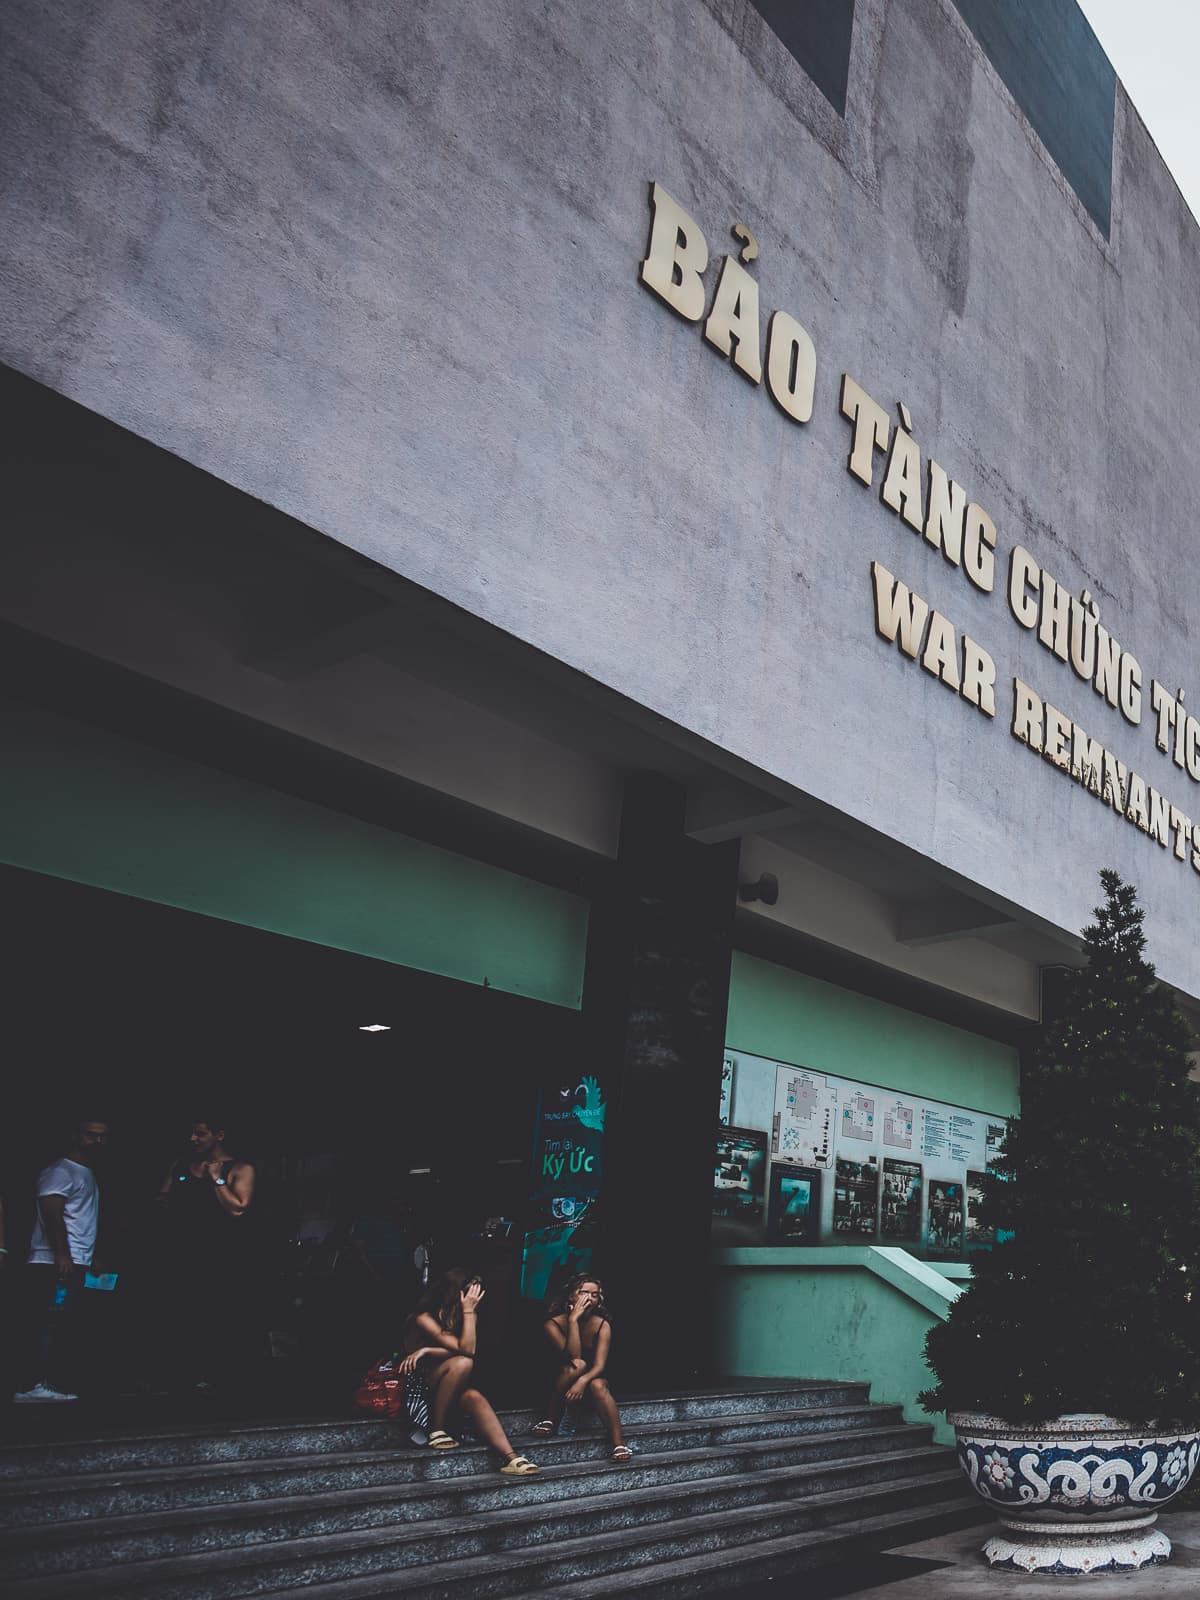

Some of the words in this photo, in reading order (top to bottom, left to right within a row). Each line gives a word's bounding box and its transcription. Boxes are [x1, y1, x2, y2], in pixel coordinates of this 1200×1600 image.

[639, 181, 817, 424] BẢO
[839, 373, 997, 593] TÀNG
[1008, 545, 1142, 726] CHỨNG
[871, 561, 996, 717] WAR
[542, 1152, 565, 1181] Ký
[570, 1146, 595, 1174] Ức
